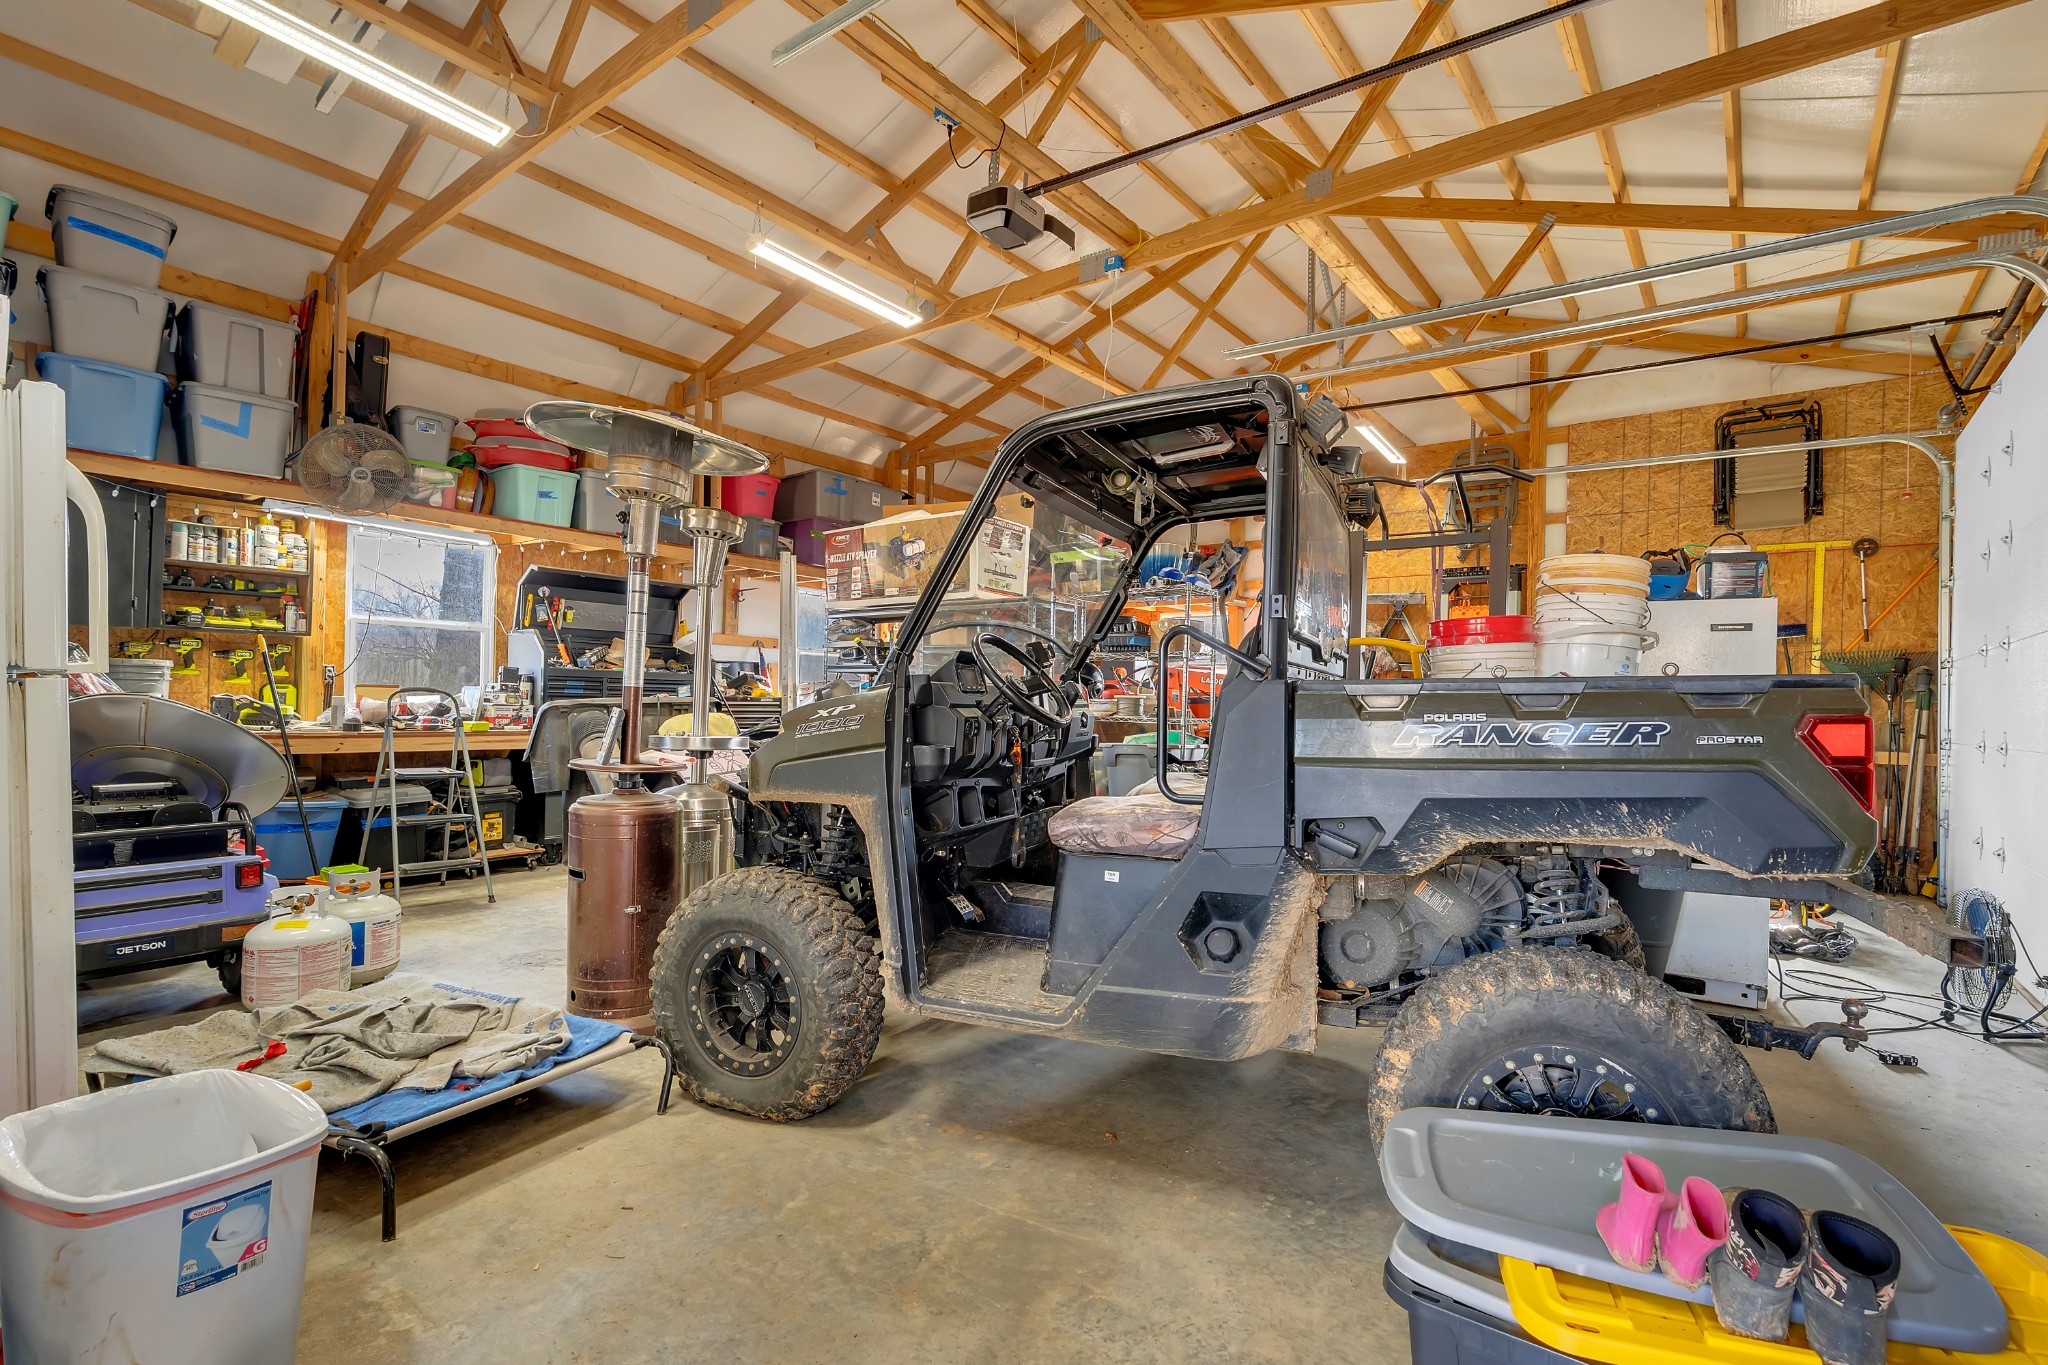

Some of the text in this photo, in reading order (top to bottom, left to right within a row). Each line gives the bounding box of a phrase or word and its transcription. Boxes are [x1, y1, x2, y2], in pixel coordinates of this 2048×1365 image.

[856, 549, 878, 561] SPRAYER
[808, 703, 857, 720] XP
[1423, 712, 1488, 723] POLARIS
[795, 714, 865, 735] 1000
[811, 727, 846, 736] OVERHEAD
[1391, 721, 1673, 748] RANGER
[1696, 735, 1764, 745] PROSTAR
[116, 941, 167, 955] JETSON
[192, 1203, 225, 1219] Sterilite
[253, 1240, 267, 1255] G
